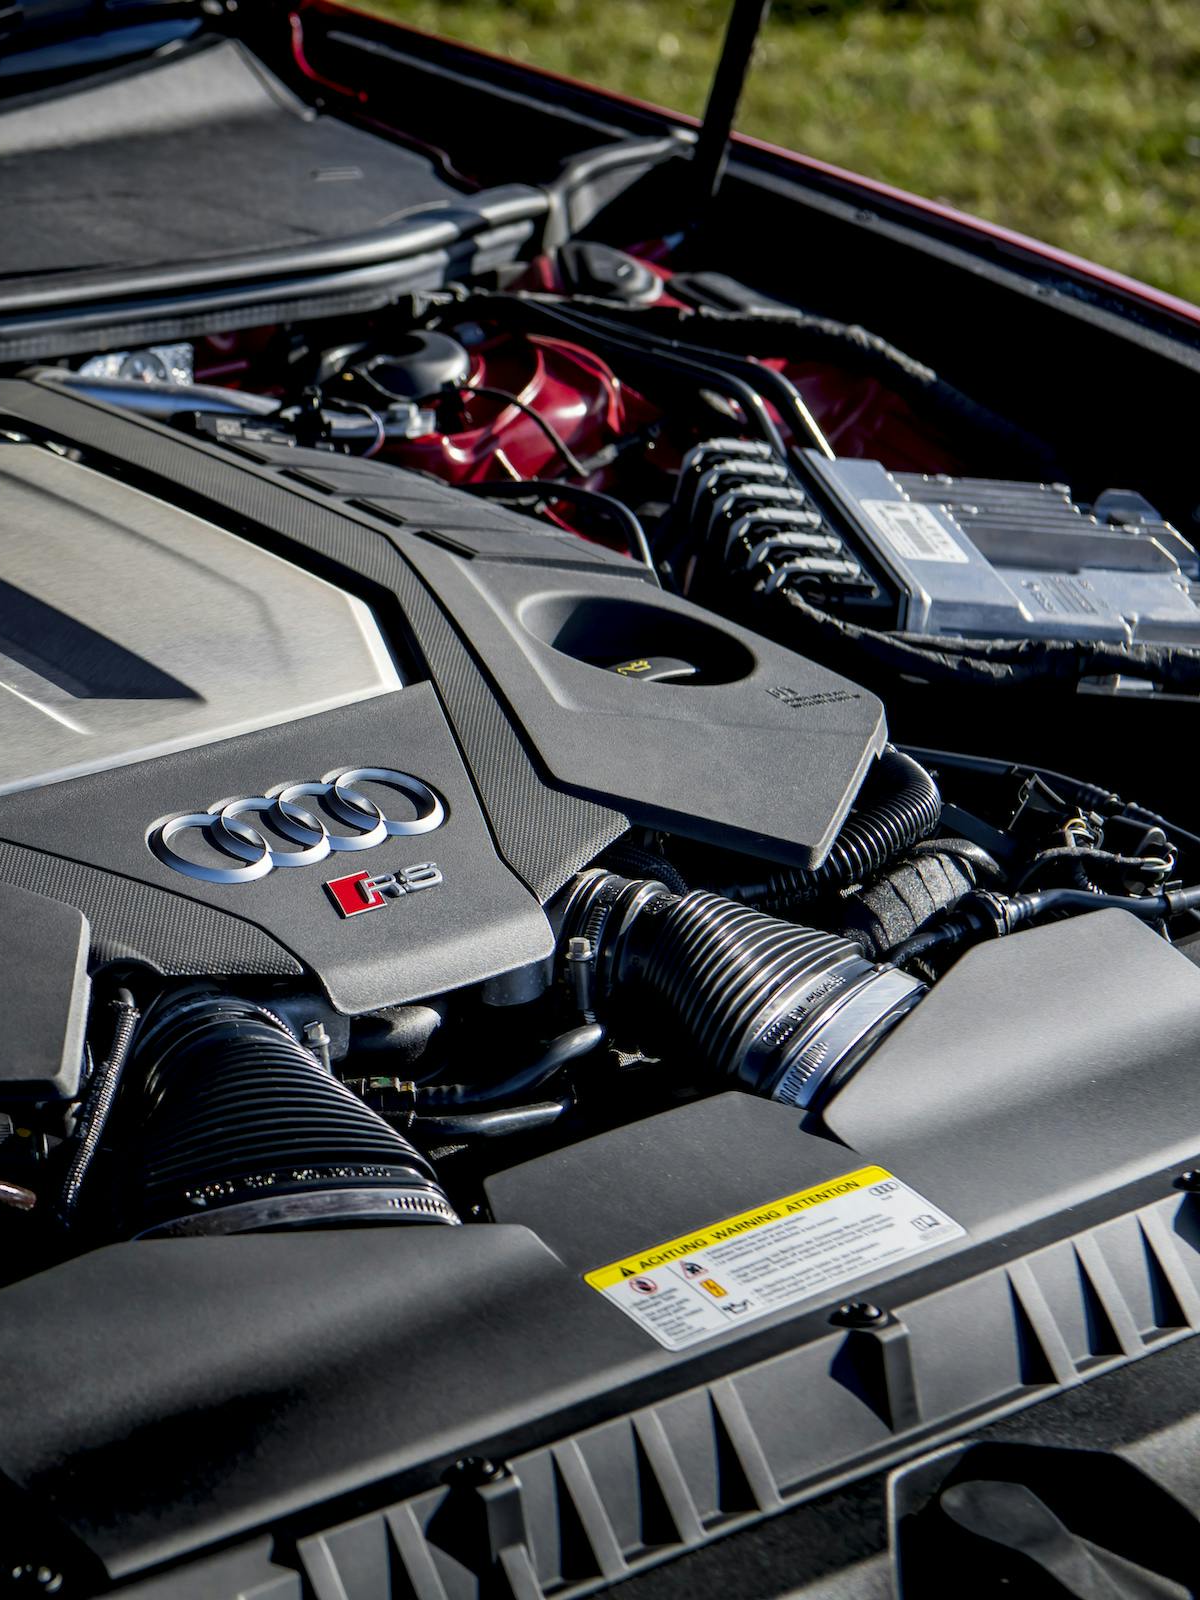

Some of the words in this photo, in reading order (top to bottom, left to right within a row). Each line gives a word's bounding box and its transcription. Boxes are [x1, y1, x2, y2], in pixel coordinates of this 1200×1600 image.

[357, 861, 443, 905] RS
[639, 1239, 708, 1270] ACHTUNG
[711, 1210, 781, 1240] WARNING
[785, 1180, 860, 1212] ATTENTION
